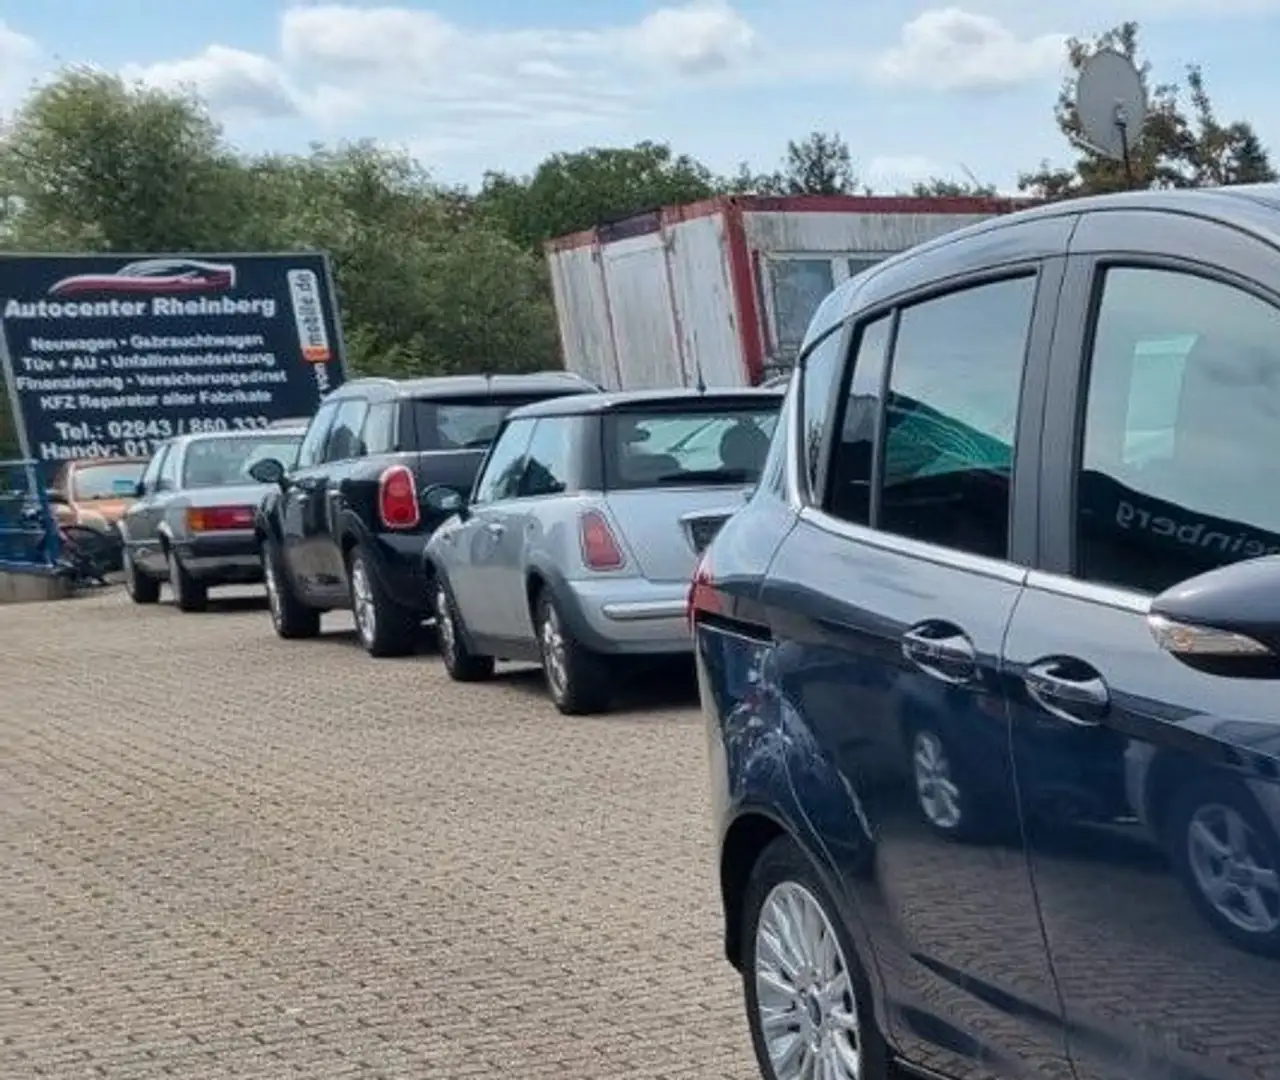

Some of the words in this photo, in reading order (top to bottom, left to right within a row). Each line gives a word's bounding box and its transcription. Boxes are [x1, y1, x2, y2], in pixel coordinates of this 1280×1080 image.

[4, 299, 146, 318] Autocenter
[152, 295, 275, 318] Rheinberg
[30, 336, 118, 352] Neuwagen
[130, 333, 264, 350] Gebrauchtwagen
[72, 355, 97, 370] AU
[16, 375, 124, 391] Finanzierung
[40, 395, 77, 411] KFZ
[79, 392, 159, 411] Reparatur
[162, 391, 196, 406] aller
[199, 389, 273, 405] Fabrikate
[54, 421, 104, 440] Tel.:
[107, 420, 172, 439] 02843
[188, 417, 228, 434] 860
